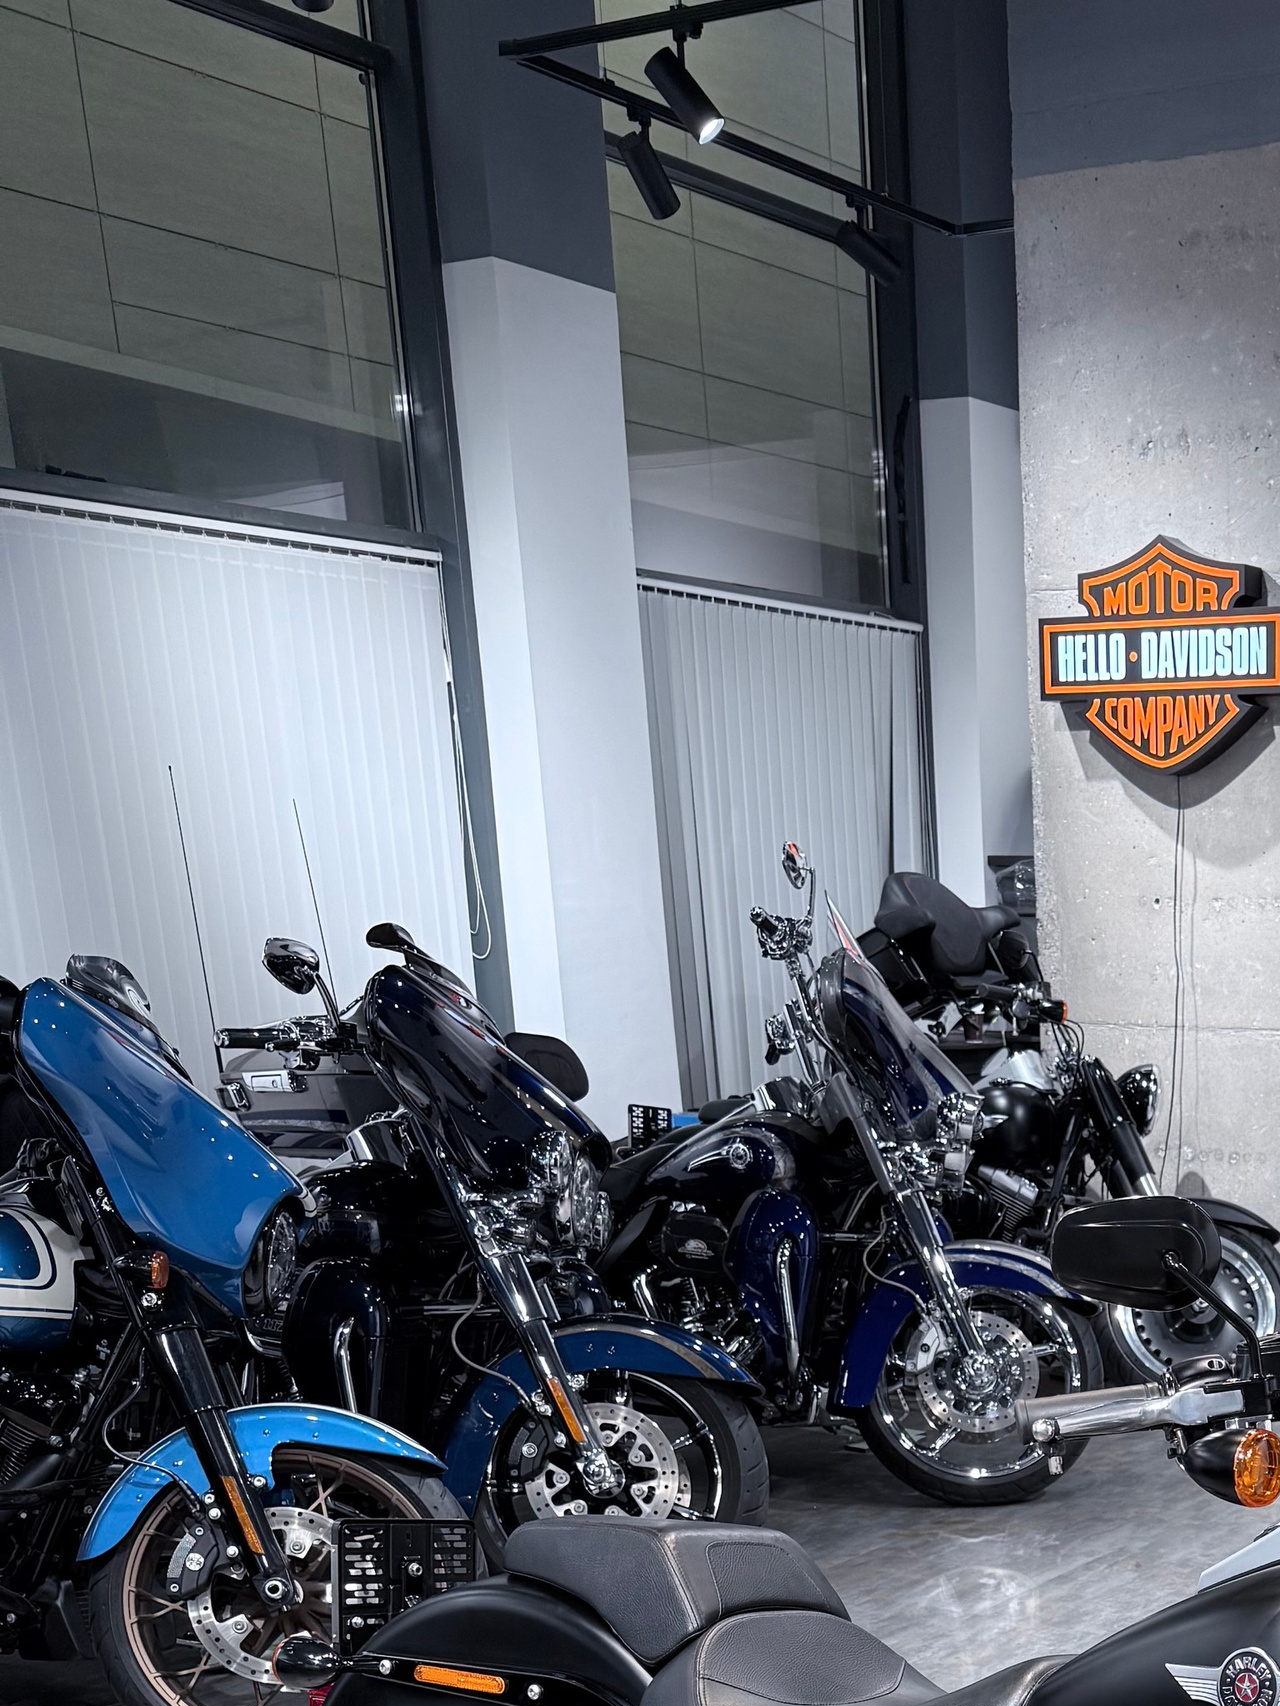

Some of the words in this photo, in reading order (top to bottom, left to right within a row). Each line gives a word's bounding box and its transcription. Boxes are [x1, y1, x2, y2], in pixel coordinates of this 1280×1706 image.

[1103, 559, 1219, 616] MOTOR
[1057, 632, 1126, 682] HELLO
[1140, 626, 1267, 679] DAVIDSON
[1104, 694, 1221, 757] COMPANY
[1225, 1656, 1272, 1680] HARLEY
